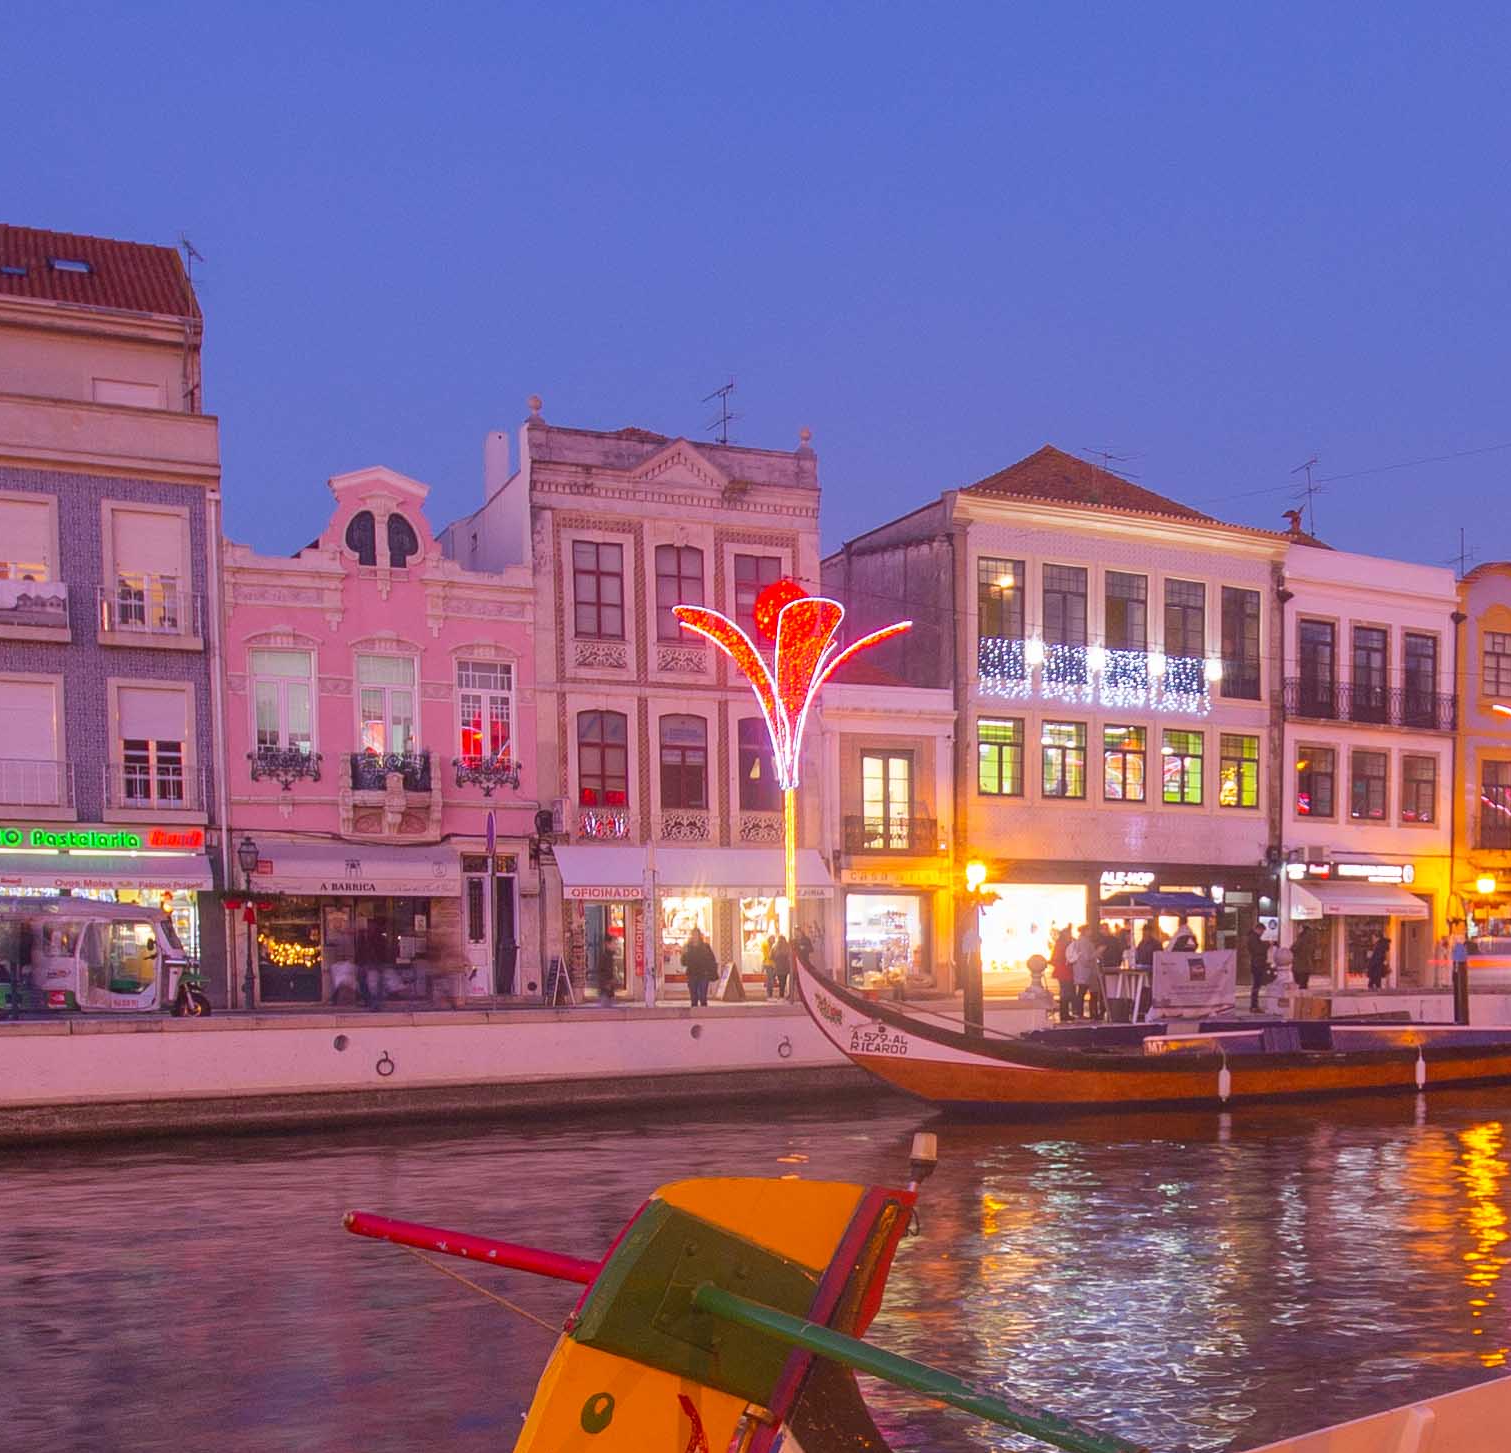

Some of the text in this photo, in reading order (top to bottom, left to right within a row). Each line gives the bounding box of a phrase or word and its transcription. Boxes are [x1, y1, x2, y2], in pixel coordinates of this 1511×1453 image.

[32, 829, 139, 847] Pastelaria
[320, 882, 329, 891] A
[850, 1042, 908, 1055] RICARDO
